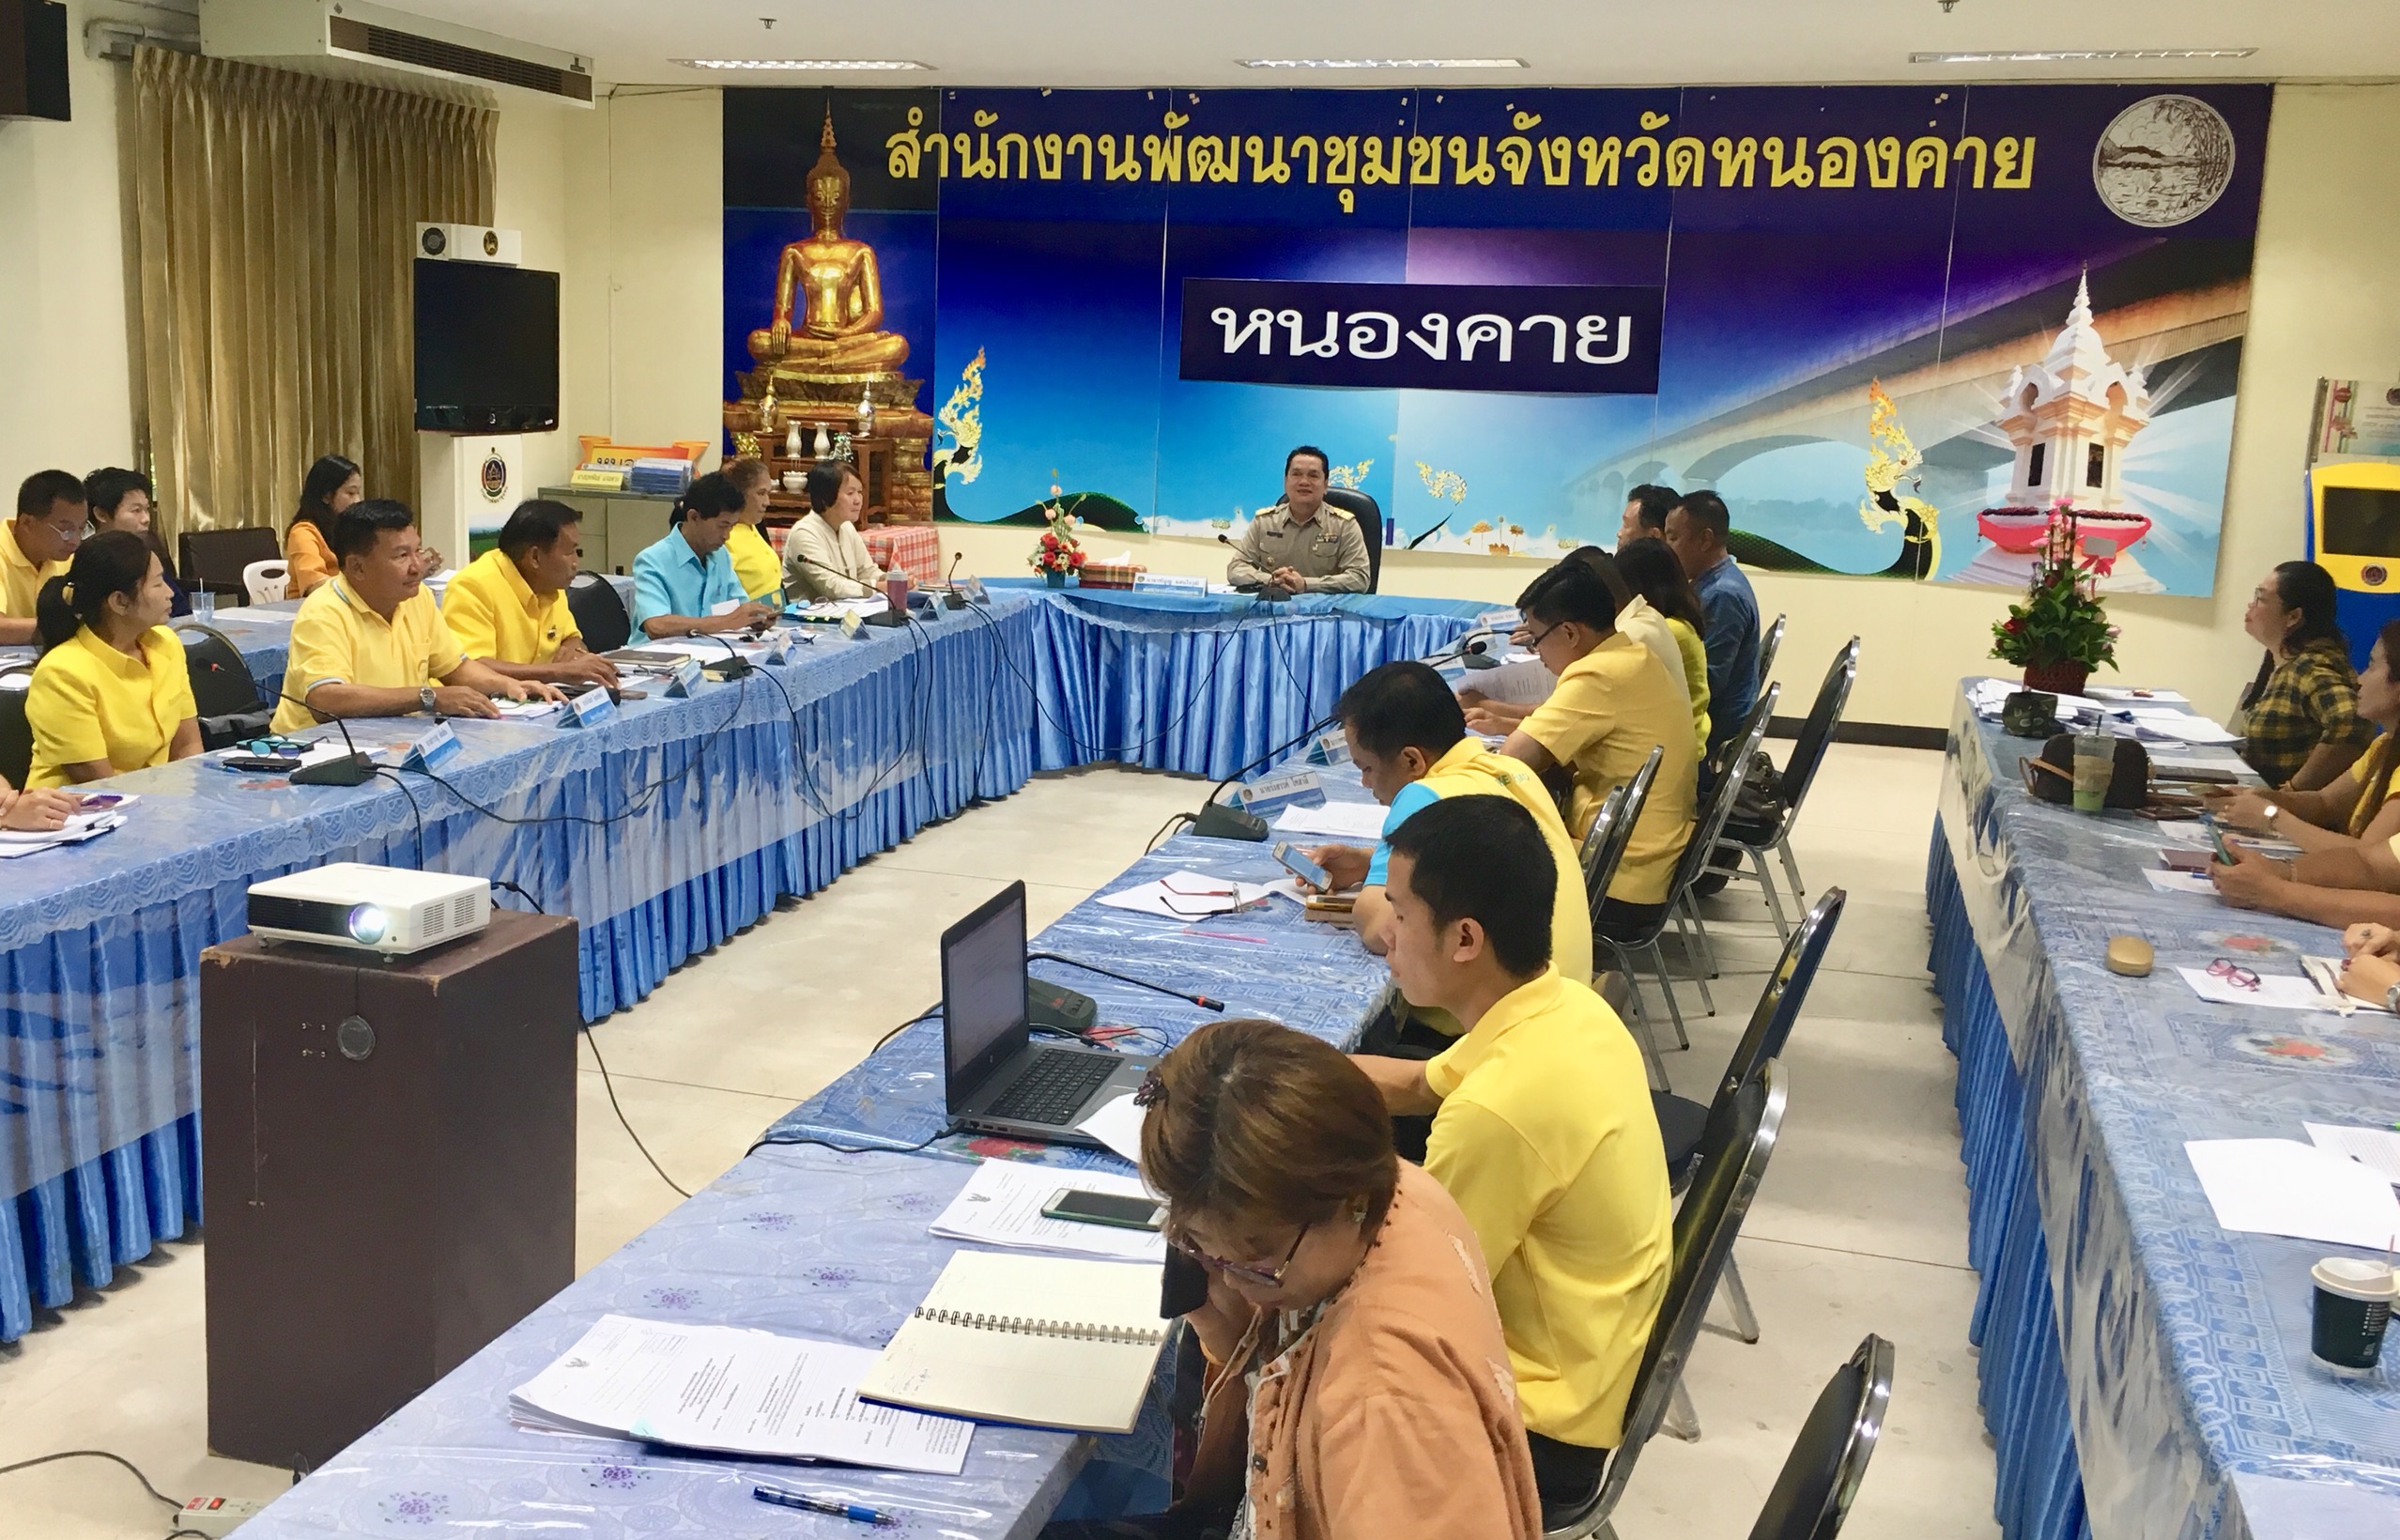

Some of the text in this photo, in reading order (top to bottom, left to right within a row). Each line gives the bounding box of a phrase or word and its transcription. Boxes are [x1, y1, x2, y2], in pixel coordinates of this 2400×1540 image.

[885, 106, 2036, 213] สำนักงานพัฒนาชุมชนจังหวัดหนองคาย
[1210, 306, 1632, 364] หนองคาย
